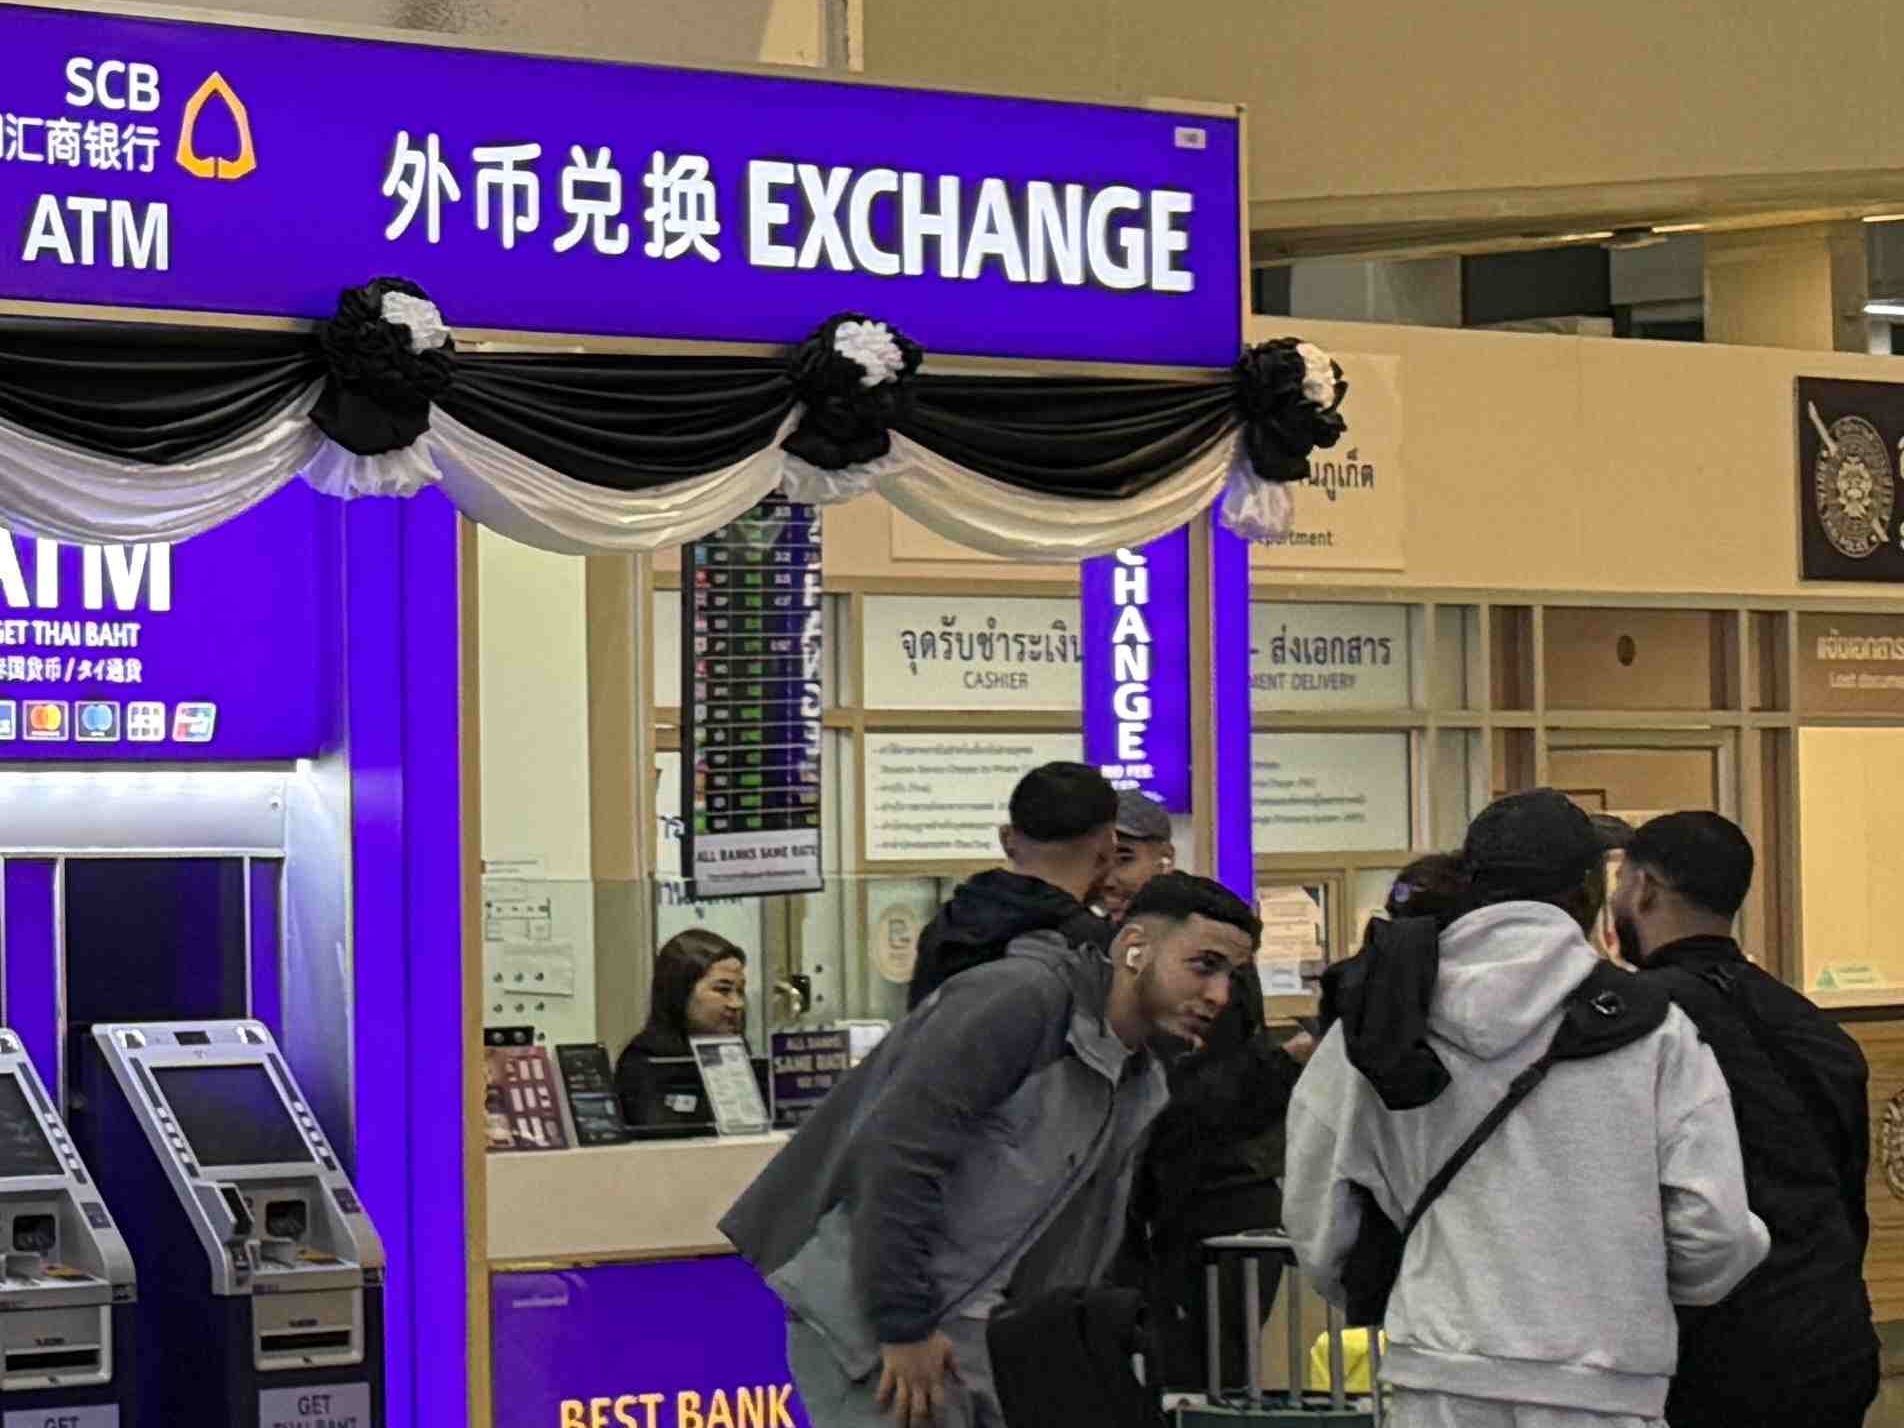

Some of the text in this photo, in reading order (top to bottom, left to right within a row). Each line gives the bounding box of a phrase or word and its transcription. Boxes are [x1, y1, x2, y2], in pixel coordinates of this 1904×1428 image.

[65, 57, 160, 112] SCB
[22, 194, 168, 271] ATM
[382, 132, 1195, 294] 外币兑换 EXCHANGE
[32, 620, 81, 646] THAI
[85, 622, 142, 648] BAHT
[963, 671, 1029, 690] CASHIER
[296, 1394, 332, 1417] GET
